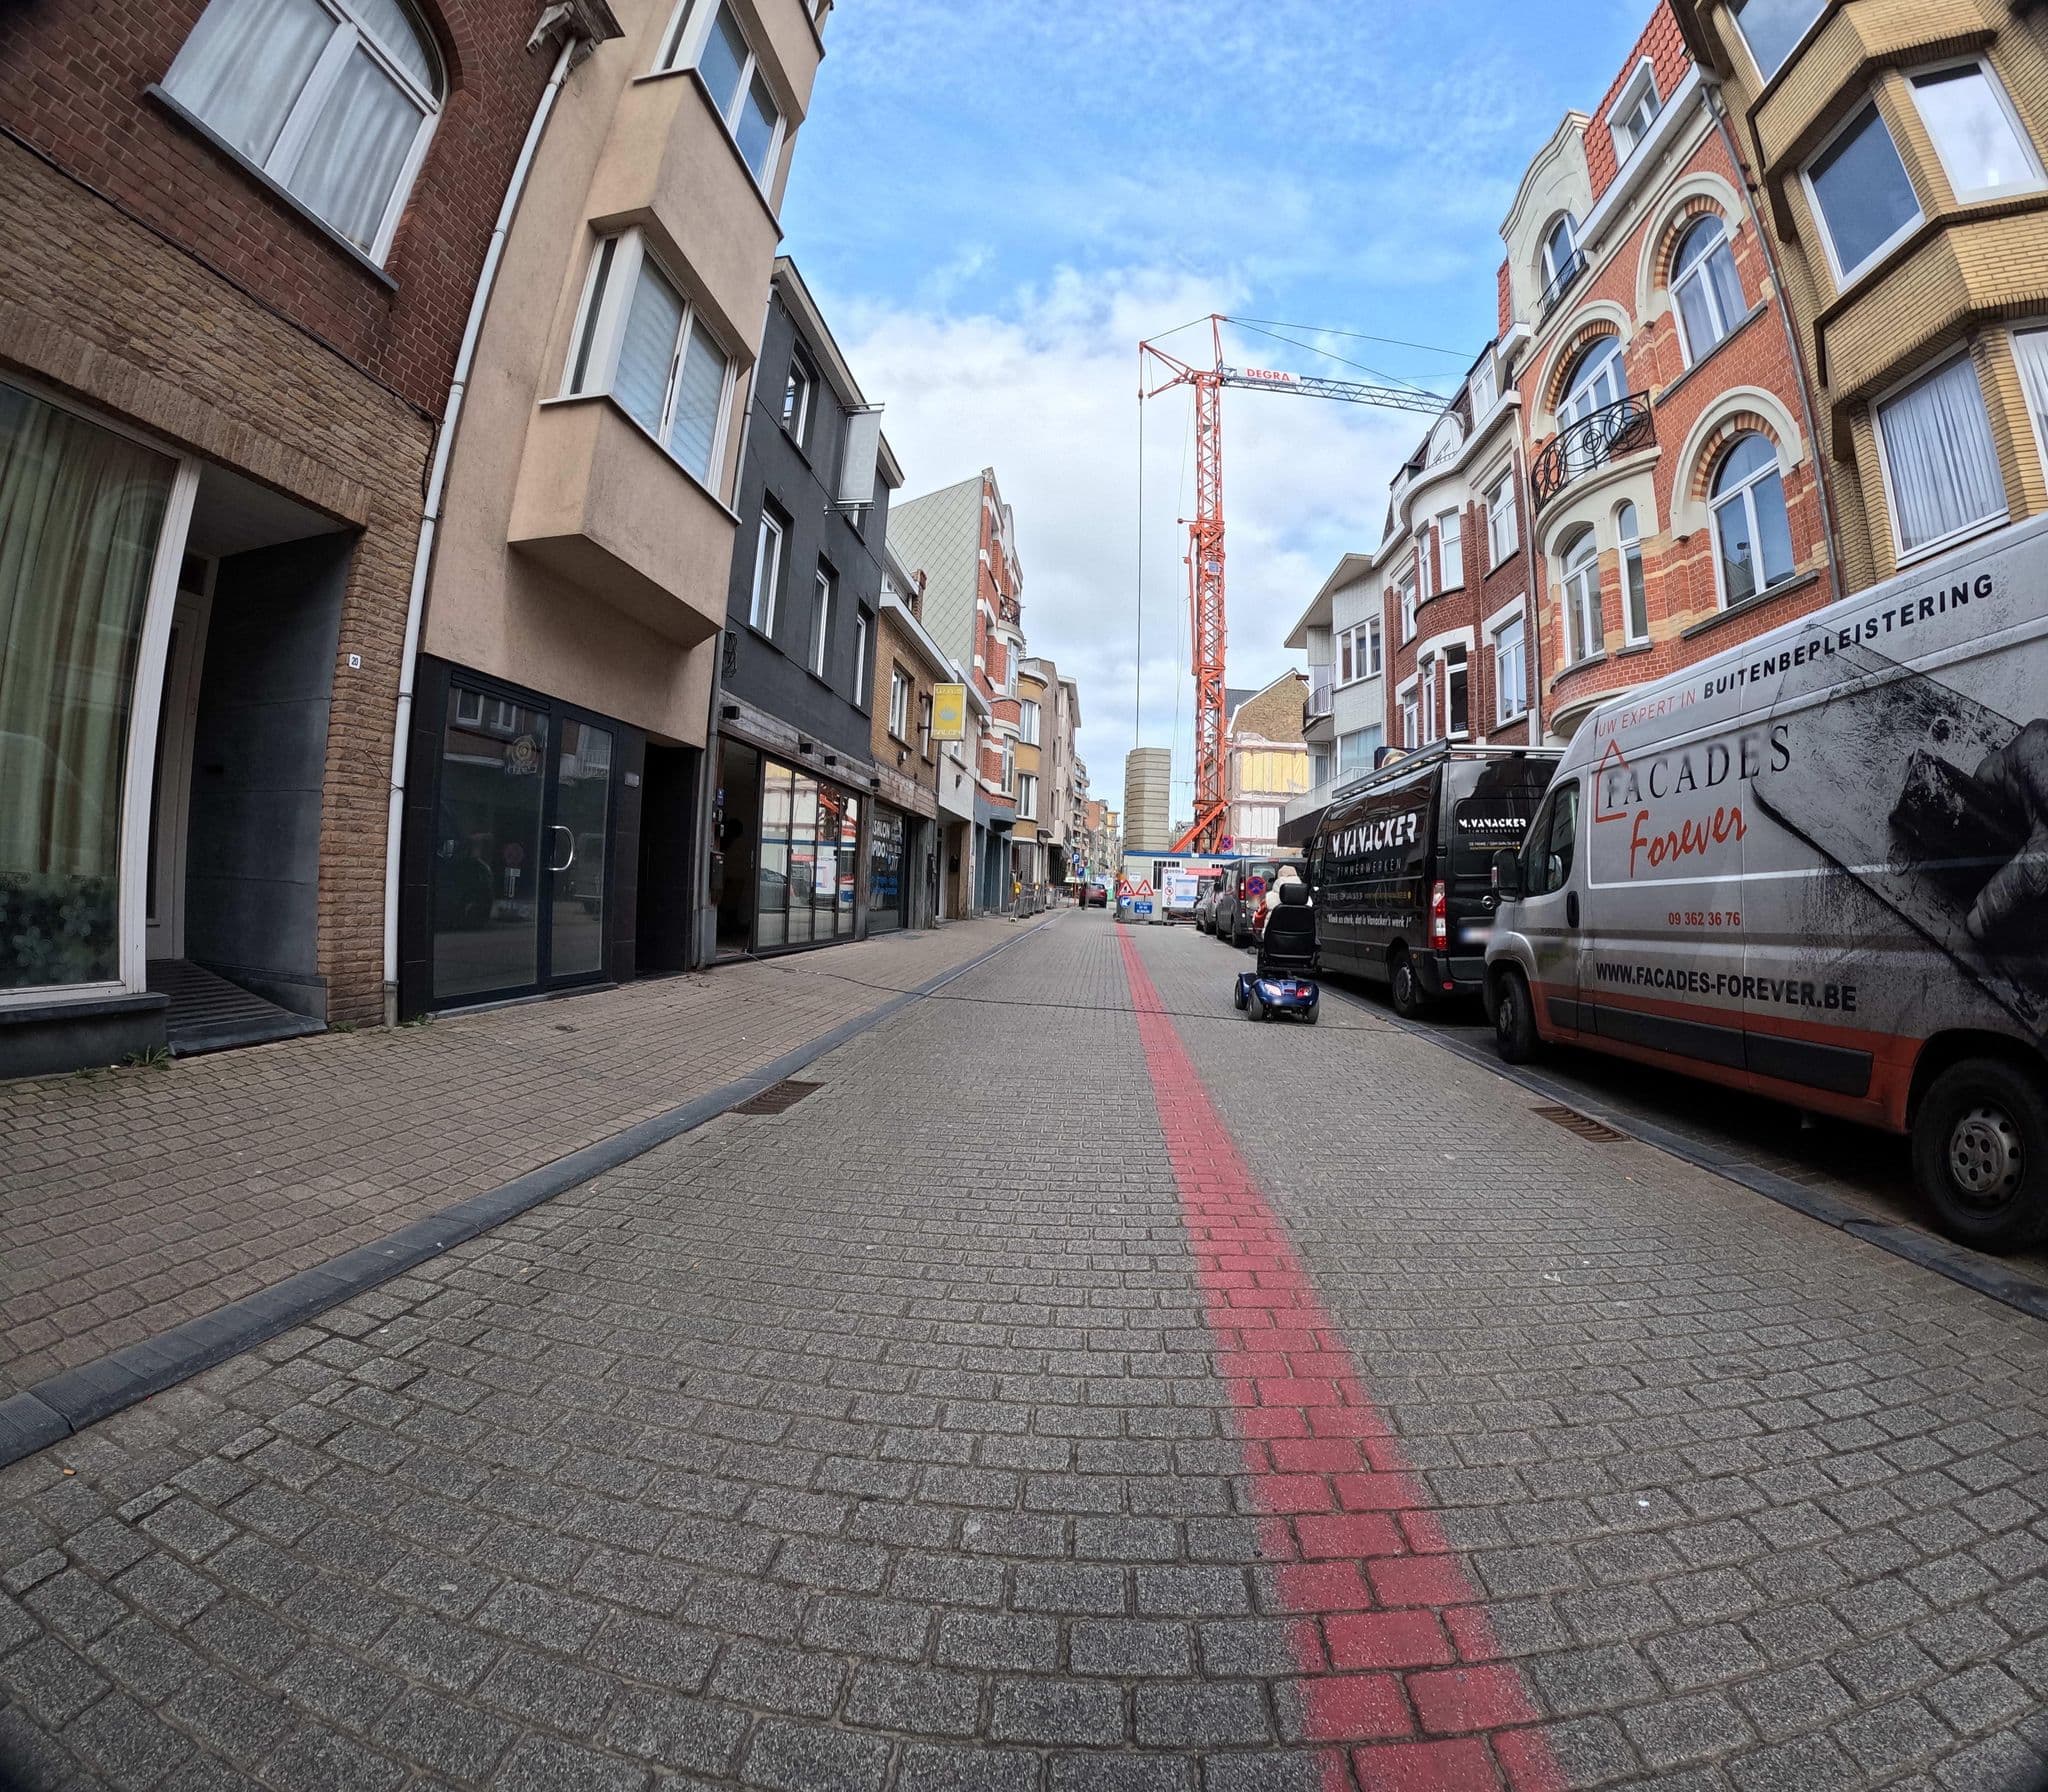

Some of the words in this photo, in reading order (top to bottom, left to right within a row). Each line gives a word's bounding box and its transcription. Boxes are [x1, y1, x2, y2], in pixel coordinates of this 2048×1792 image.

[1247, 368, 1290, 381] DEGRA
[1598, 717, 1618, 737] UW
[1621, 695, 1675, 729] EXPERT
[1680, 688, 1697, 709] IN
[1704, 573, 1994, 699] BUITENBEPLEISTERING
[1606, 724, 1791, 808] FACADES
[1630, 806, 1748, 878] Forever
[1668, 912, 1681, 926] 09
[1684, 912, 1704, 926] 362
[1708, 912, 1722, 926] 36
[1725, 912, 1741, 926] 76
[1596, 962, 1857, 1013] WWW.FACADES-FOREVER.BE
